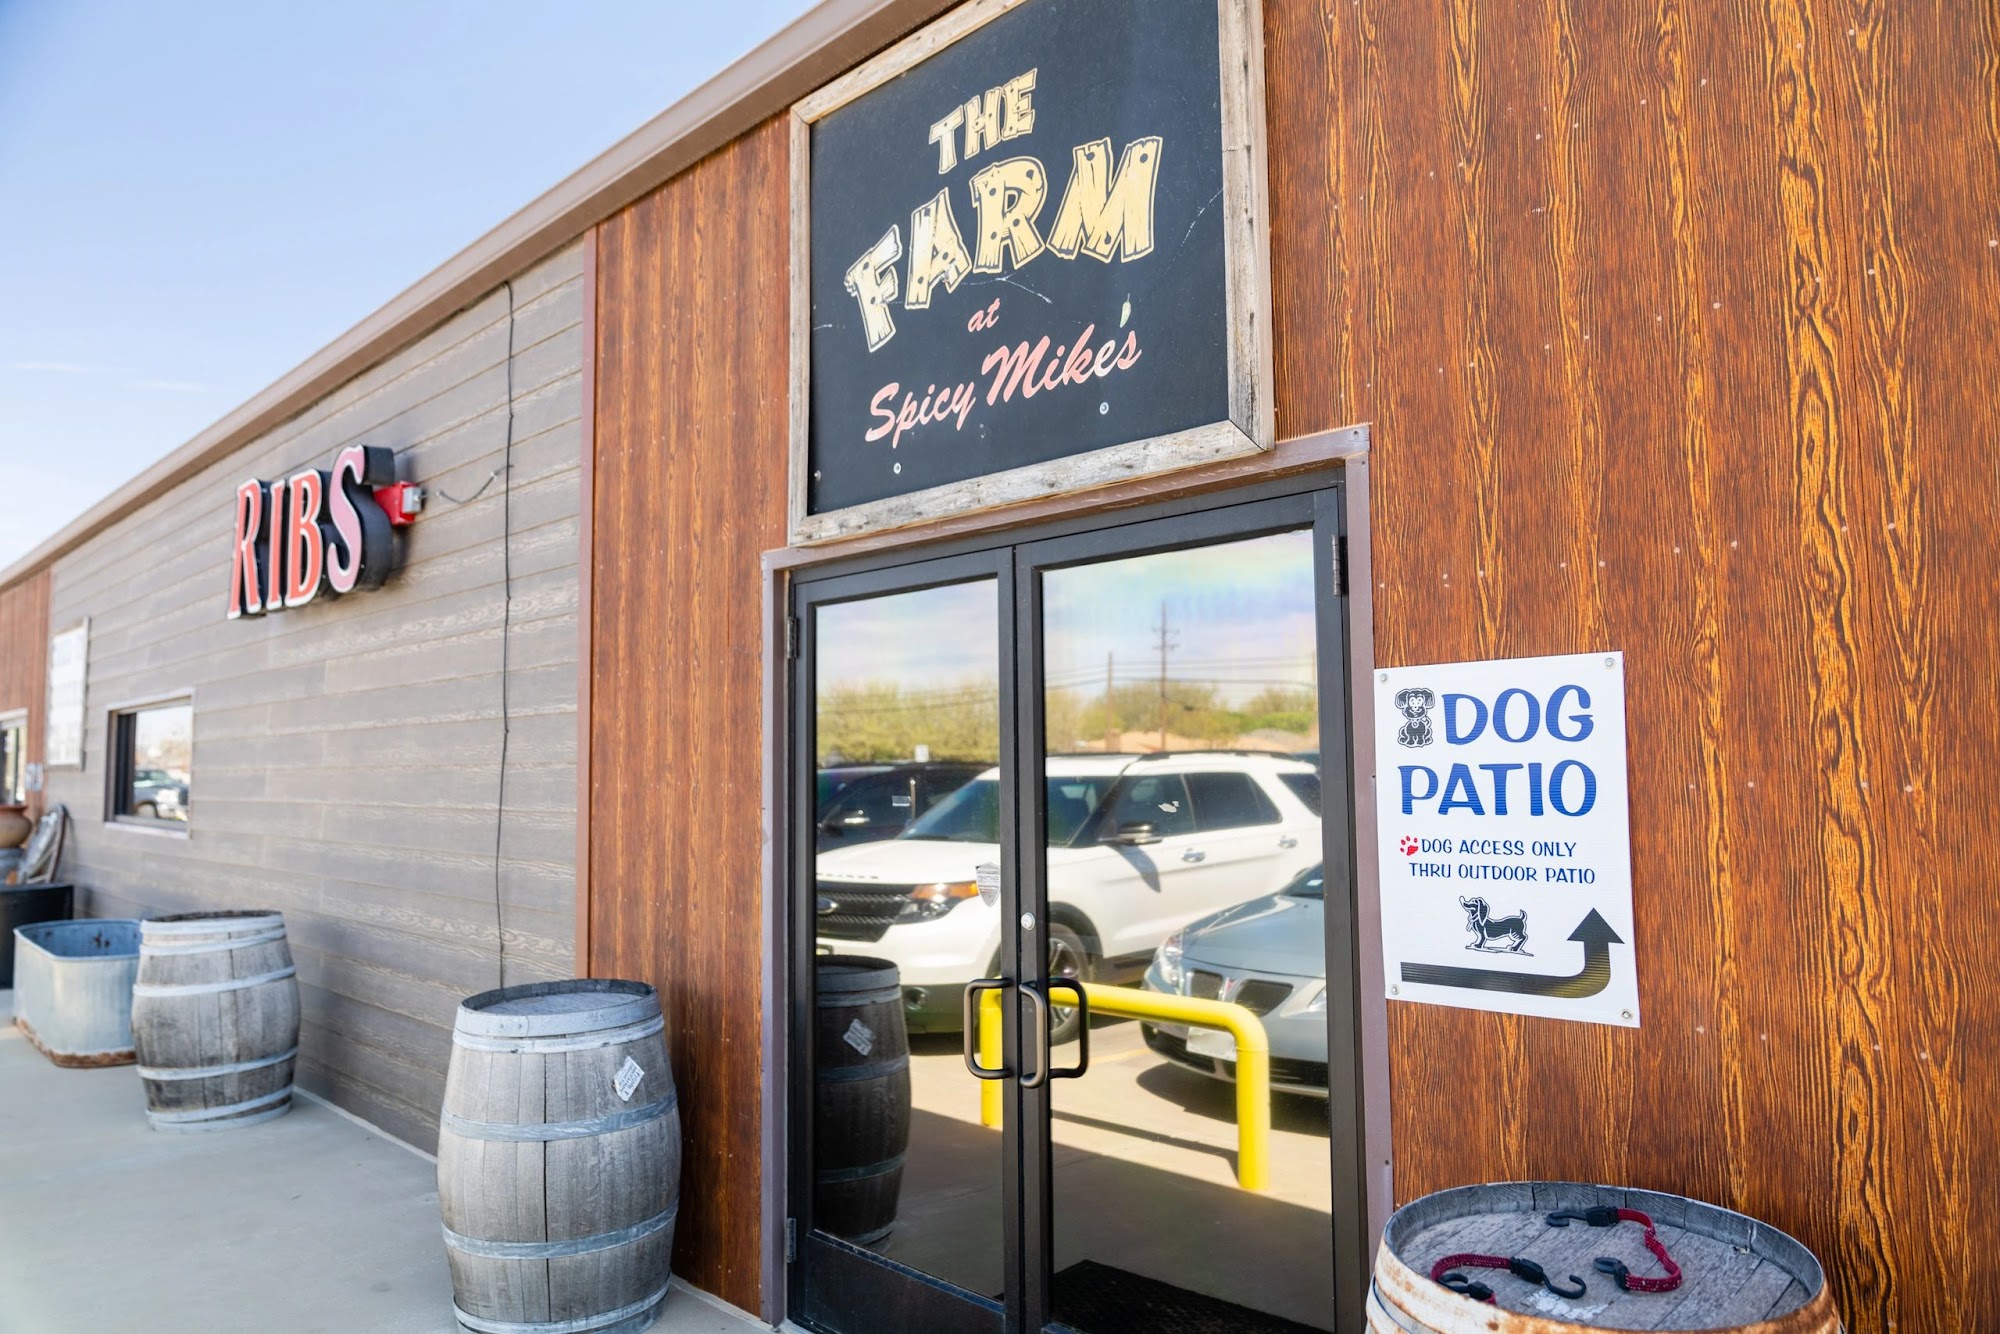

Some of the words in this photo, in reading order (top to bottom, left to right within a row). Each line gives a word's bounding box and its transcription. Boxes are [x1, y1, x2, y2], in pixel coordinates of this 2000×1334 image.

[928, 67, 1038, 174] THE
[843, 136, 1163, 353] FARM
[967, 298, 1000, 333] at
[864, 381, 976, 449] Spicy
[226, 444, 367, 620] RIBS
[1442, 684, 1594, 745] DOG
[1397, 759, 1597, 817] PATIO
[1409, 862, 1452, 879] THRU
[1458, 864, 1538, 882] OUTDOOR
[1545, 867, 1596, 884] PATIO
[1421, 838, 1452, 854] DOG
[1459, 839, 1525, 857] ACCESS
[1531, 841, 1577, 858] ONLY
